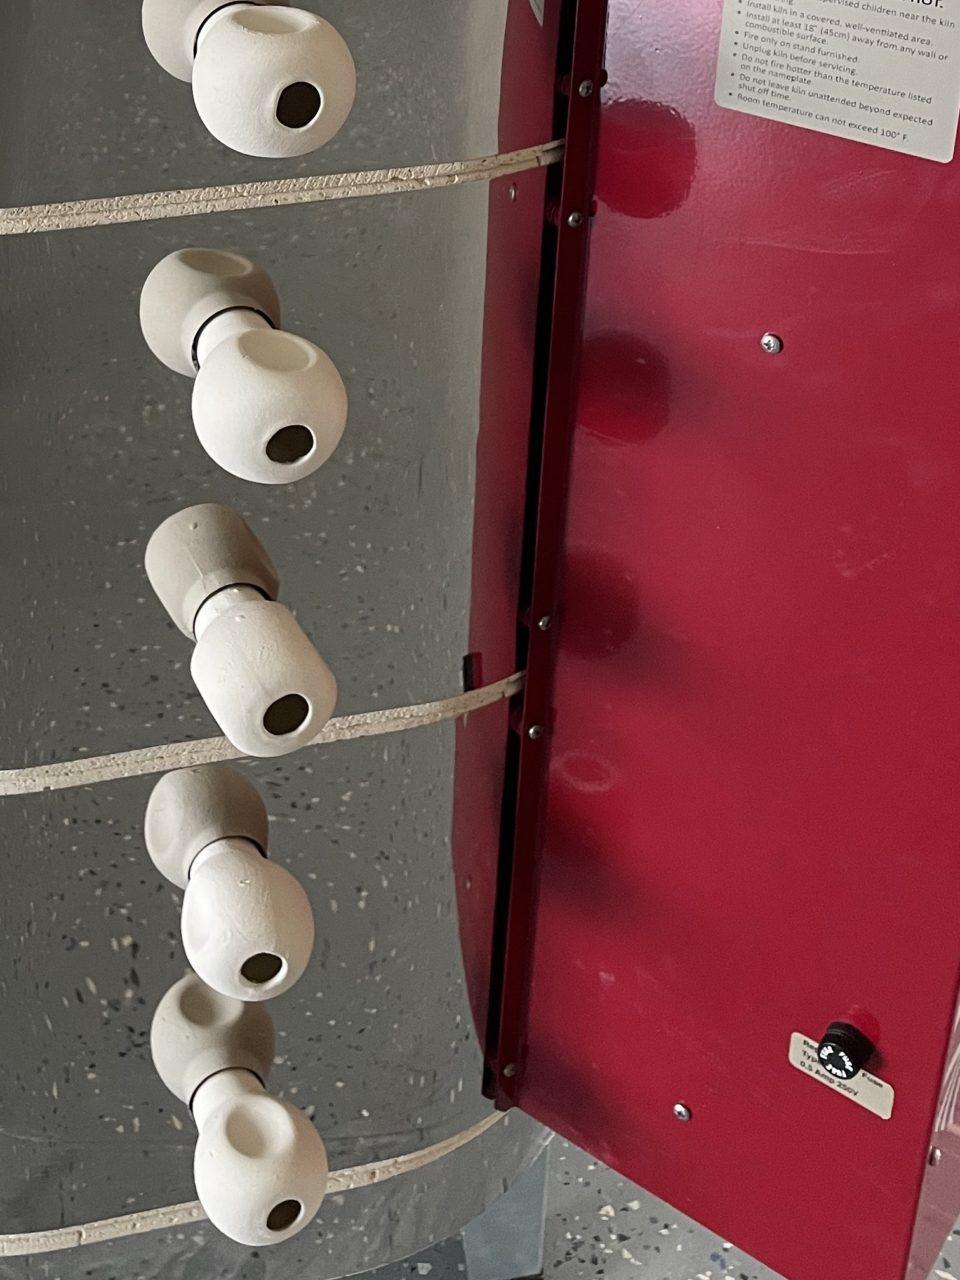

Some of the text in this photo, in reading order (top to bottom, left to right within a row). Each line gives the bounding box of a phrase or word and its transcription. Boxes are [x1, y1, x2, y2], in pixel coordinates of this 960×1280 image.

[745, 20, 795, 37] combustible
[747, 0, 772, 11] Install
[773, 5, 788, 15] kiln
[790, 8, 798, 16] in
[845, 22, 909, 41] well-ventilated
[862, 3, 897, 16] children
[899, 10, 920, 20] near
[922, 14, 937, 25] the
[939, 18, 955, 29] kiln
[744, 31, 759, 40] Fire
[760, 35, 778, 46] only
[780, 40, 790, 48] on
[792, 43, 816, 54] stand
[746, 11, 770, 22] Install
[782, 19, 801, 29] least
[820, 27, 850, 41] (45cm)
[852, 34, 874, 46] away
[876, 39, 898, 50] from
[899, 46, 916, 56] any
[918, 49, 936, 59] wall
[742, 42, 771, 57] Unplug
[773, 50, 788, 59] kiln
[790, 53, 816, 66] before
[741, 53, 933, 105] Do not fire hotter than the temperature listed
[753, 65, 767, 73] the
[738, 82, 755, 92] shut
[757, 87, 769, 96] off
[739, 72, 933, 127] Do not leave kiln unattended beyond expected
[737, 93, 760, 104] Room
[762, 99, 813, 118] temperature
[815, 112, 830, 122] can
[831, 117, 846, 127] not
[848, 122, 878, 134] exceed
